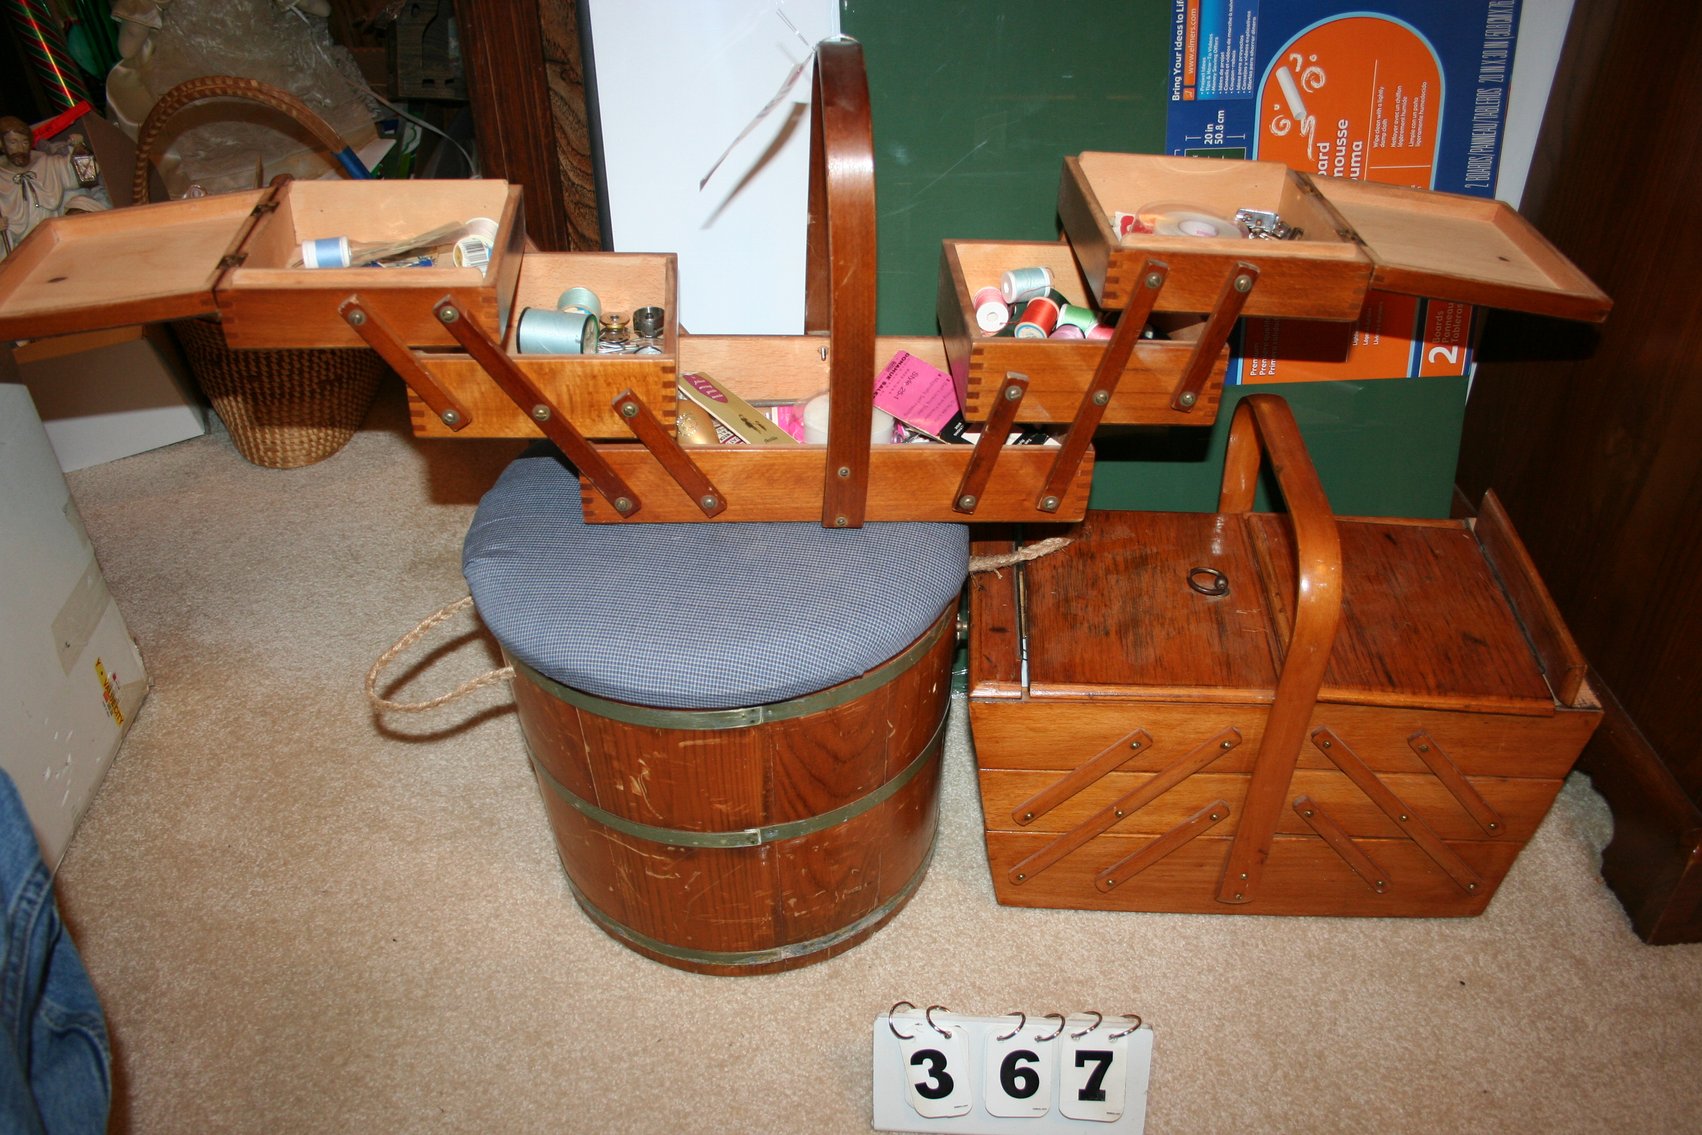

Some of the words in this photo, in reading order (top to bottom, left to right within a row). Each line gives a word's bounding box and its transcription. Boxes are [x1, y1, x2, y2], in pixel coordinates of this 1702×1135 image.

[1176, 14, 1183, 23] to
[1174, 25, 1183, 50] Ideas
[1188, 8, 1197, 74] www.elmers.com
[1173, 52, 1182, 75] Your
[1482, 50, 1508, 59] 30
[1172, 76, 1182, 101] Bring
[1478, 74, 1504, 83] 20
[1204, 123, 1214, 132] in
[1217, 110, 1225, 124] cm
[1204, 133, 1213, 145] 20
[1214, 125, 1224, 145] 50.8
[1350, 141, 1363, 180] uma
[1432, 310, 1445, 343] Boards
[1441, 302, 1454, 343] Panneau
[1451, 303, 1464, 343] Tableros
[886, 352, 910, 381] DONAHUE
[1428, 345, 1459, 364] 2
[910, 1048, 954, 1100] 3
[1000, 1049, 1040, 1099] 6
[1074, 1050, 1114, 1102] 7
